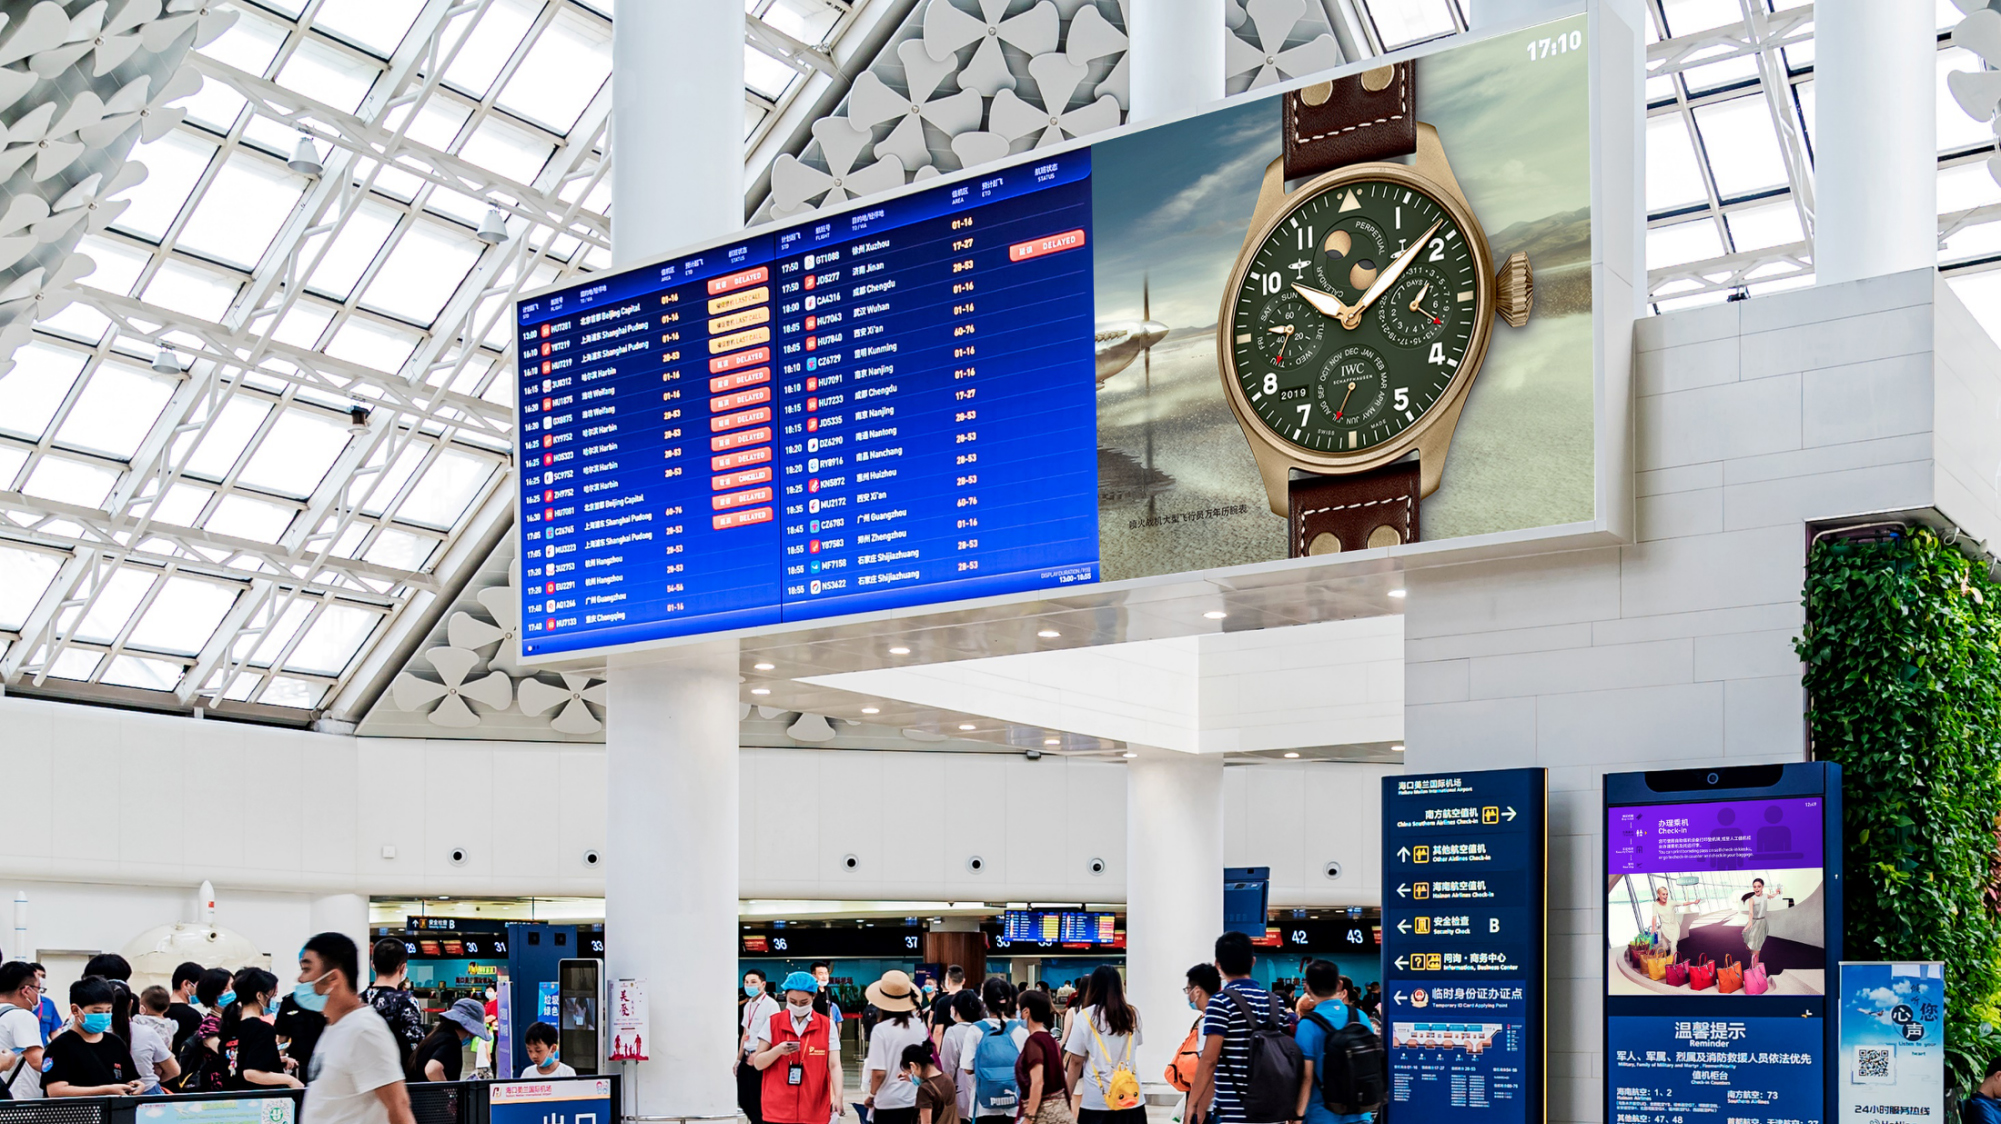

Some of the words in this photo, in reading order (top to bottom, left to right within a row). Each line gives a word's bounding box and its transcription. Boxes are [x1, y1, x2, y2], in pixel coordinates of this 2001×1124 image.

[1527, 30, 1582, 62] 17:10
[781, 260, 799, 274] 17:50
[866, 237, 889, 252] Xuzhou
[952, 216, 972, 230] 01-16
[1297, 225, 1313, 250] 11
[1355, 220, 1385, 255] PERPETUAL
[866, 259, 884, 273] Jinan
[952, 237, 972, 252] 17-27
[1042, 236, 1076, 250] DELAYED
[1428, 237, 1445, 262] 2
[782, 301, 799, 314] 18:00
[866, 277, 895, 295] Chengdu
[952, 259, 973, 273] 28-53
[1262, 271, 1282, 296] 10
[1316, 266, 1344, 298] CALENDAR
[1406, 279, 1423, 287] DAYS
[1281, 292, 1298, 301] SUN
[867, 300, 889, 314] Wuhan
[1260, 305, 1272, 321] SAT
[1285, 311, 1294, 320] 60
[867, 322, 883, 335] Xi'an
[1316, 322, 1325, 340] TUE
[1257, 336, 1265, 350] FRI
[1294, 332, 1304, 341] 20
[783, 361, 800, 374] 18:10
[953, 323, 974, 337] 60-76
[1344, 347, 1359, 357] DEC
[1361, 348, 1375, 359] JAN
[1428, 342, 1445, 367] 4
[1295, 350, 1313, 365] WED
[1329, 352, 1343, 367] NOV
[1374, 357, 1385, 371] FEB
[783, 382, 800, 394] 18:10
[817, 373, 842, 387] HU7091
[954, 345, 974, 359] 01-16
[1319, 365, 1331, 381] OCT
[1341, 362, 1365, 377] IWC
[1262, 373, 1279, 395] 8
[1333, 374, 1373, 385] SCHAFFHAUSEN
[1380, 371, 1388, 389] MAR
[783, 402, 801, 414] 18:15
[954, 366, 975, 380] 01-16
[1280, 388, 1307, 401] 2019
[1317, 384, 1325, 399] SEP
[1374, 390, 1385, 407] APR
[1393, 387, 1410, 411] 5
[1296, 403, 1312, 427] 7
[1320, 400, 1331, 415] AUG
[1362, 406, 1376, 420] MAY
[1317, 428, 1335, 436] SWISS
[1370, 418, 1387, 429] MADE
[1346, 416, 1360, 425] JUN
[784, 442, 802, 454] 18:20
[955, 410, 976, 423] 28-53
[786, 523, 804, 535] 18:45
[956, 496, 977, 509] 60-76
[787, 564, 804, 575] 18:55
[957, 539, 978, 552] 28-53
[787, 584, 805, 595] 18:55
[957, 561, 978, 573] 28-53
[1425, 807, 1478, 820] 南方航空值机
[1432, 843, 1486, 856] 其他航空值机
[449, 920, 456, 929] B
[1433, 916, 1470, 927] 安全检查
[1489, 918, 1500, 933] B
[773, 938, 788, 950] 36
[904, 936, 918, 949] 37
[1292, 930, 1308, 945] 42
[1346, 929, 1364, 944] 43
[405, 942, 416, 954] 29
[466, 942, 478, 952] 30
[494, 942, 506, 952] 31
[591, 940, 603, 952] 33
[1432, 988, 1523, 1000] 临时身份证办证点
[1920, 1002, 1938, 1022] 您
[1674, 1022, 1746, 1040] 温馨提示
[1690, 1039, 1730, 1048] Reminder
[1692, 1070, 1728, 1081] 值机柜台
[990, 1096, 1015, 1106] PUMA
[1854, 1104, 1930, 1116] 24小时服务热线
